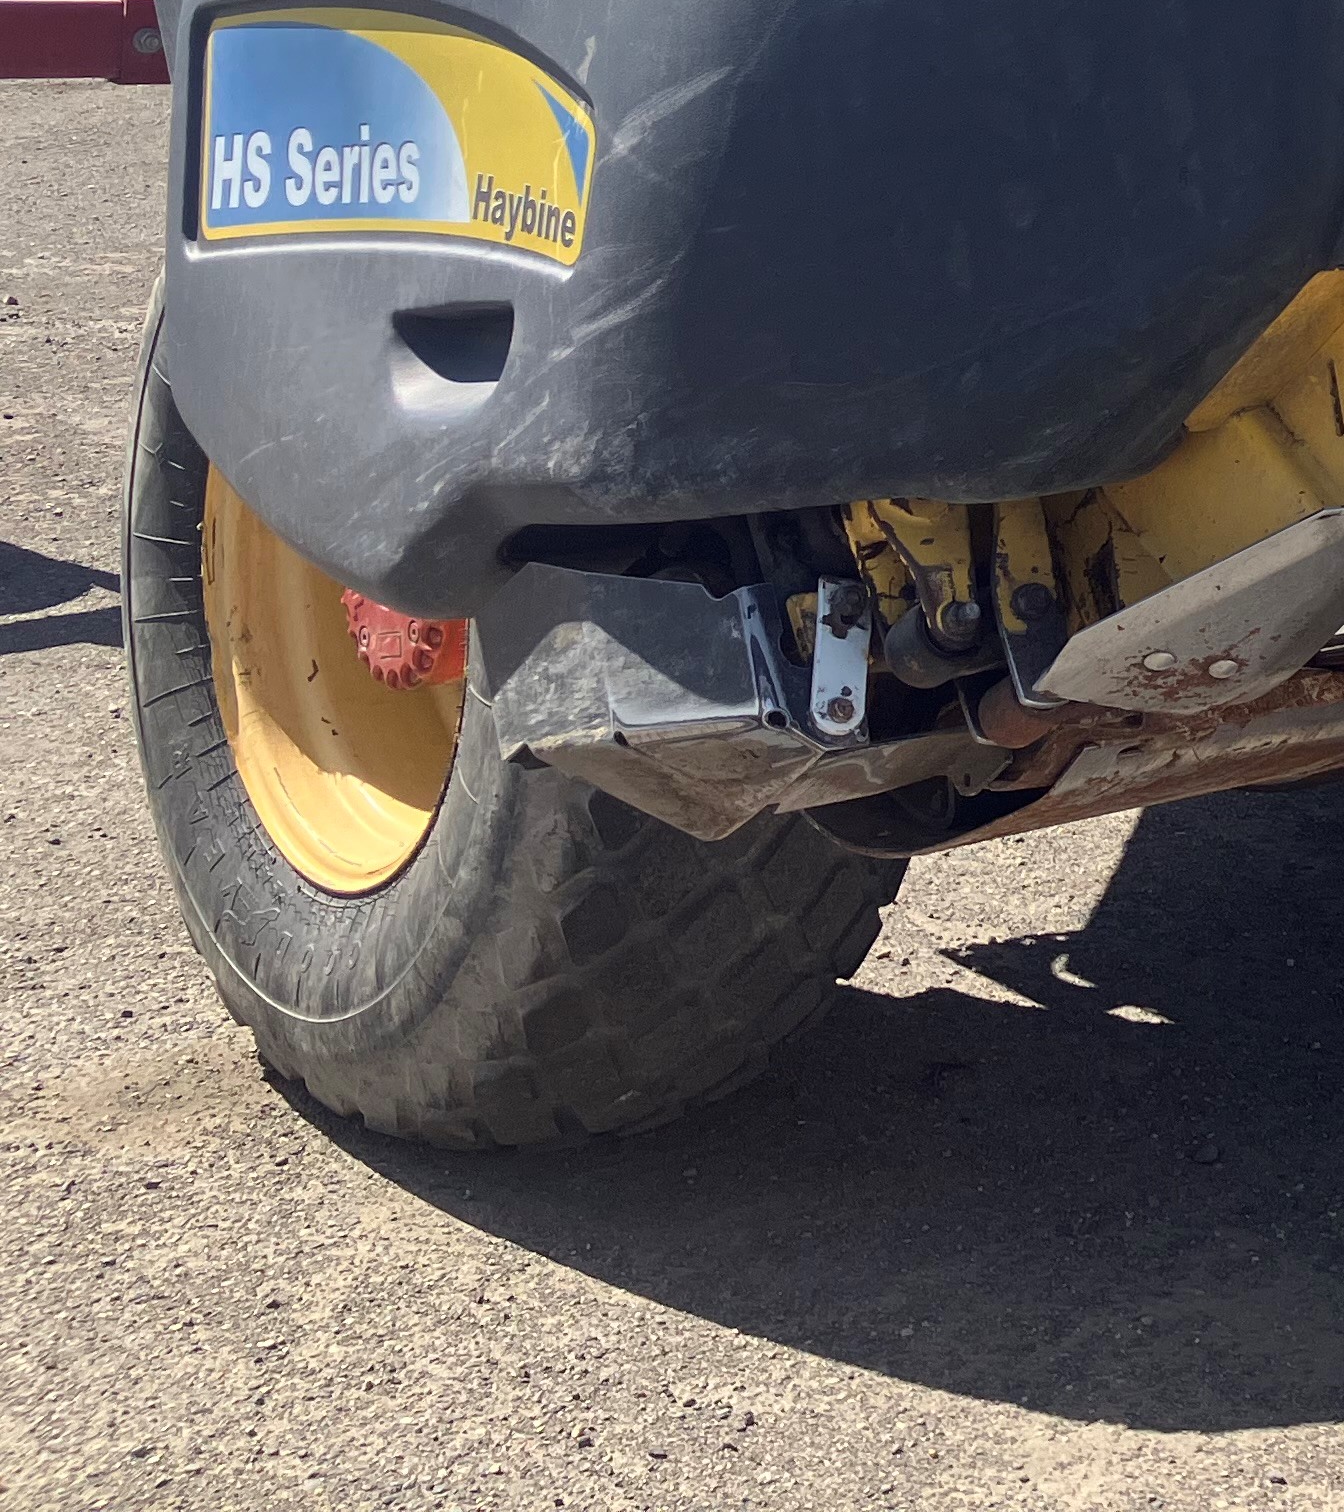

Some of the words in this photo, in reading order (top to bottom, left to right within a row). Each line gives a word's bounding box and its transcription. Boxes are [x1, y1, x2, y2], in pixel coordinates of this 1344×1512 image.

[210, 129, 272, 210] HS
[284, 122, 421, 207] Series
[472, 172, 577, 249] Haybine
